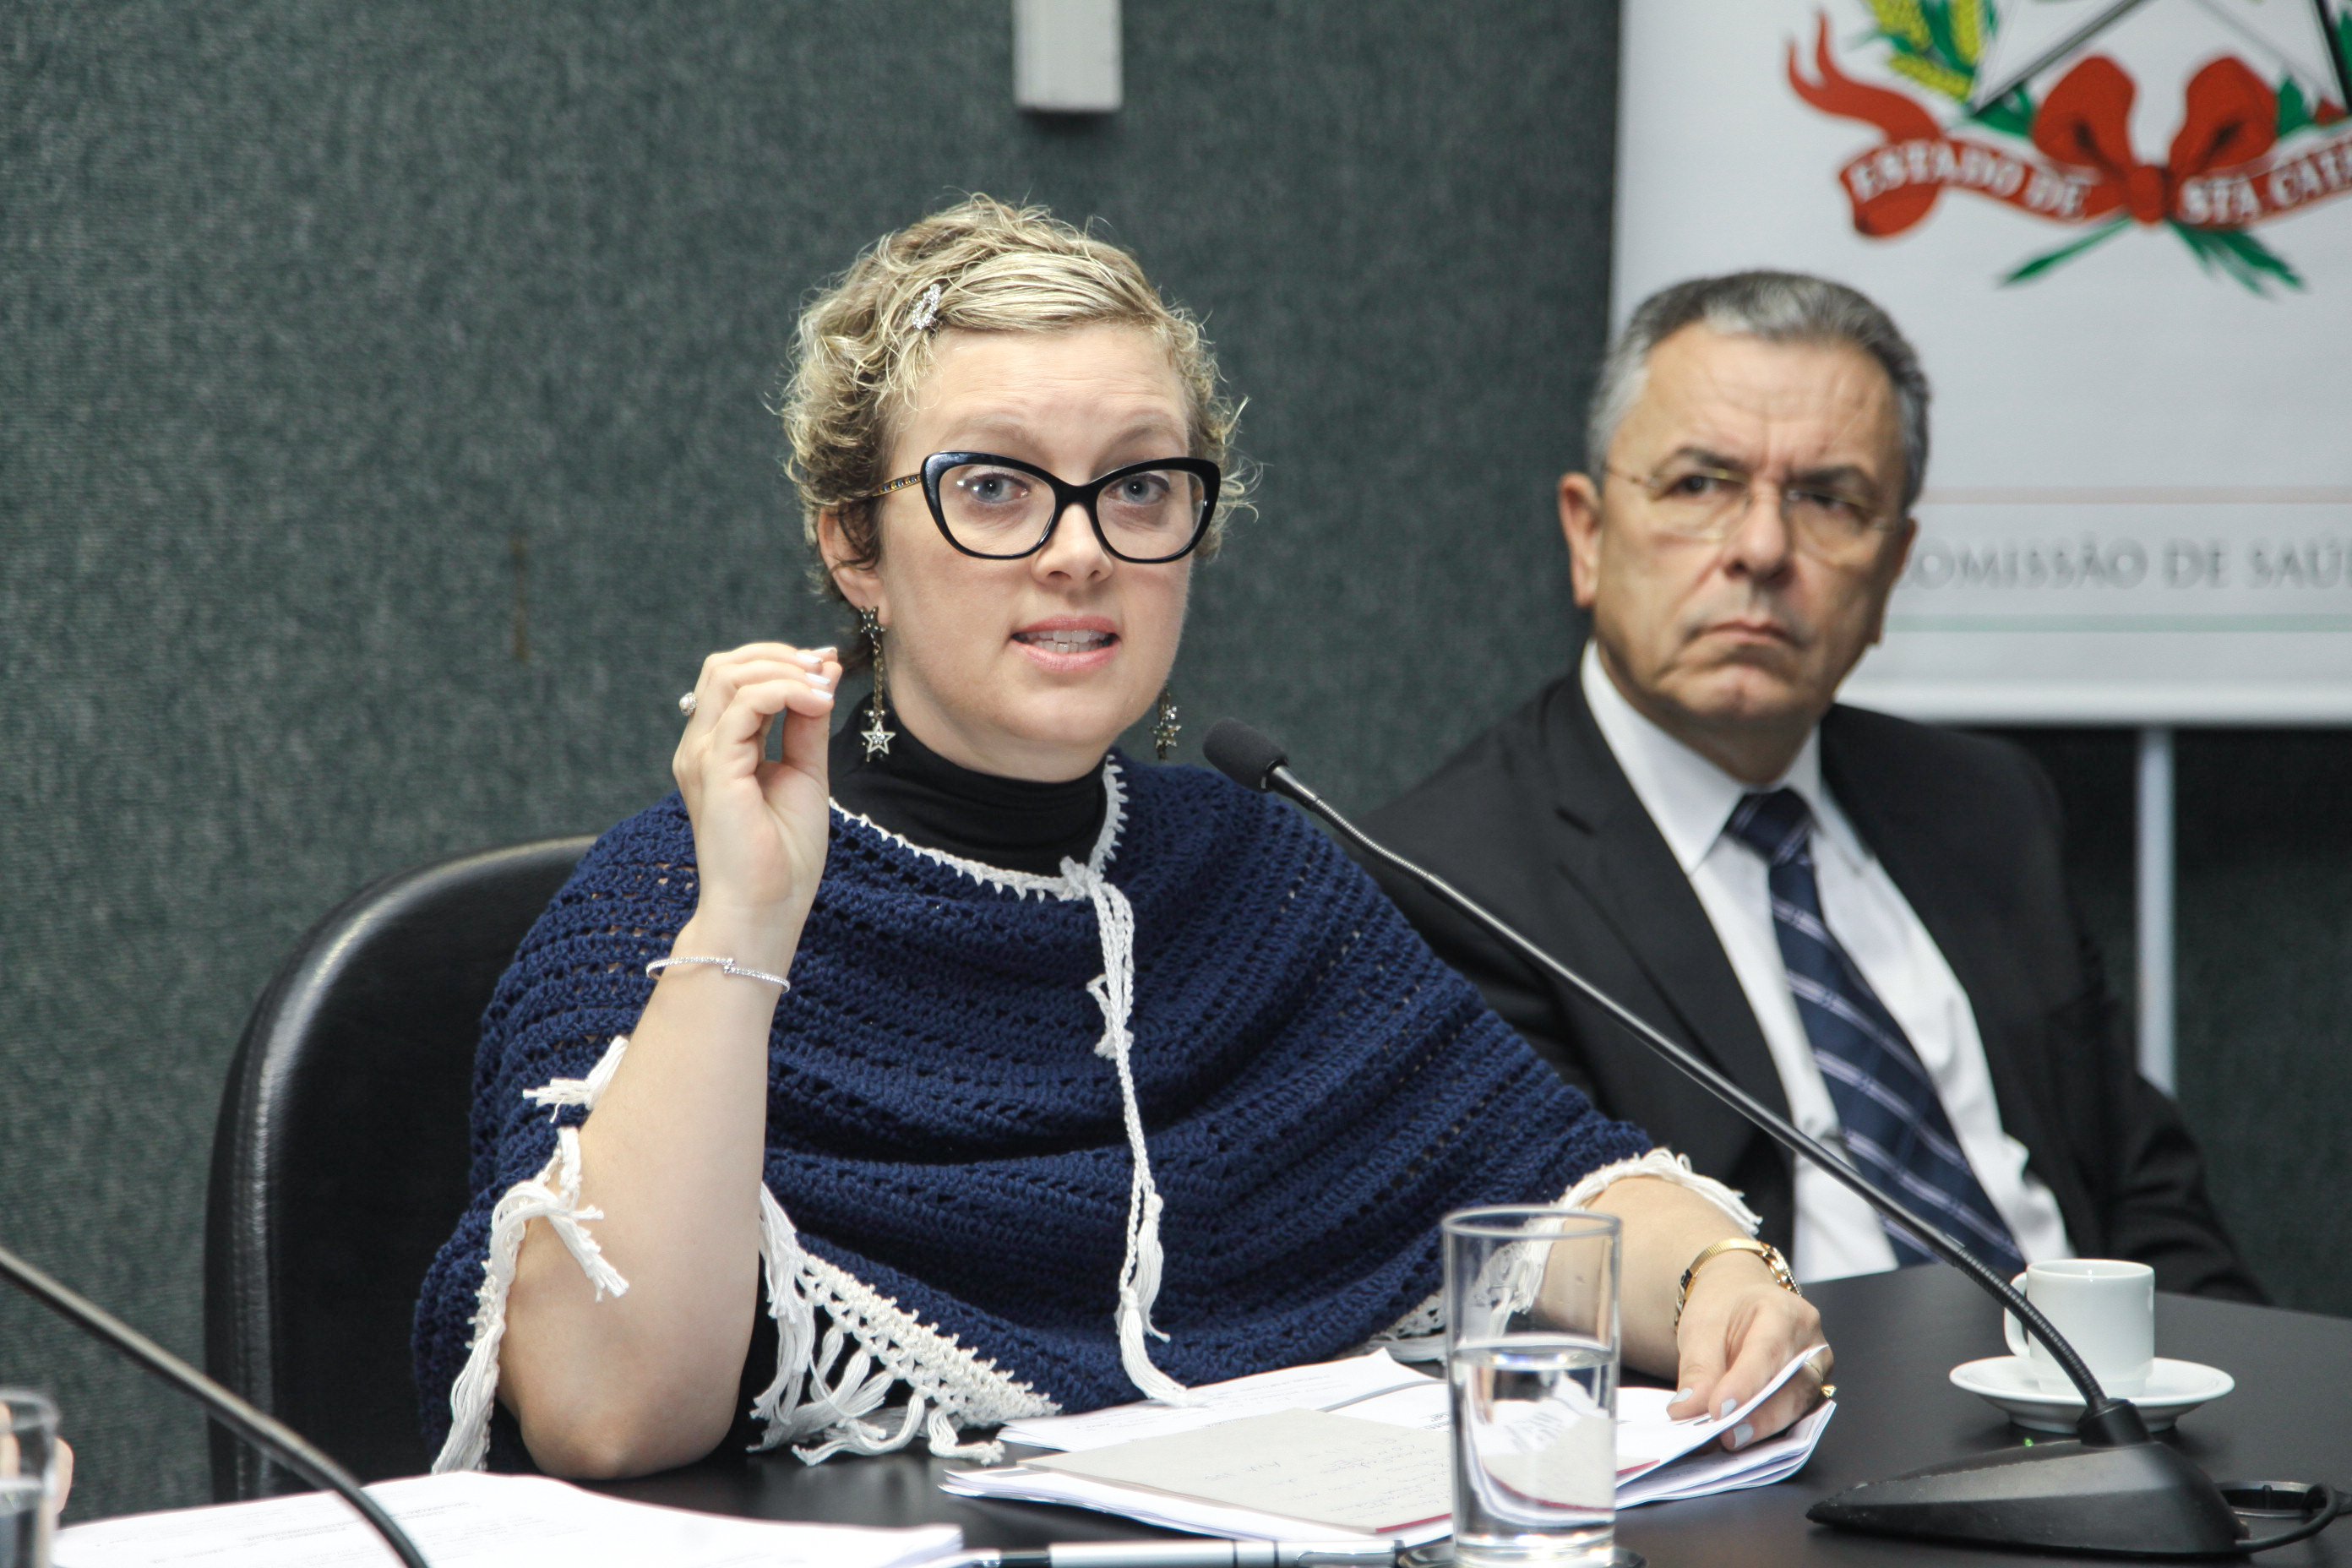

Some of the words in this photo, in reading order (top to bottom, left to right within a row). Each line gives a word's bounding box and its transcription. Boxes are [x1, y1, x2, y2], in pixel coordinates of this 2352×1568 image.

[1849, 139, 2024, 203] ESTADO
[2025, 172, 2089, 219] DE
[2180, 174, 2261, 223] STA
[1904, 532, 2148, 590] OMISSÃO
[2161, 536, 2231, 590] DE
[2246, 532, 2352, 590] SAÚ
